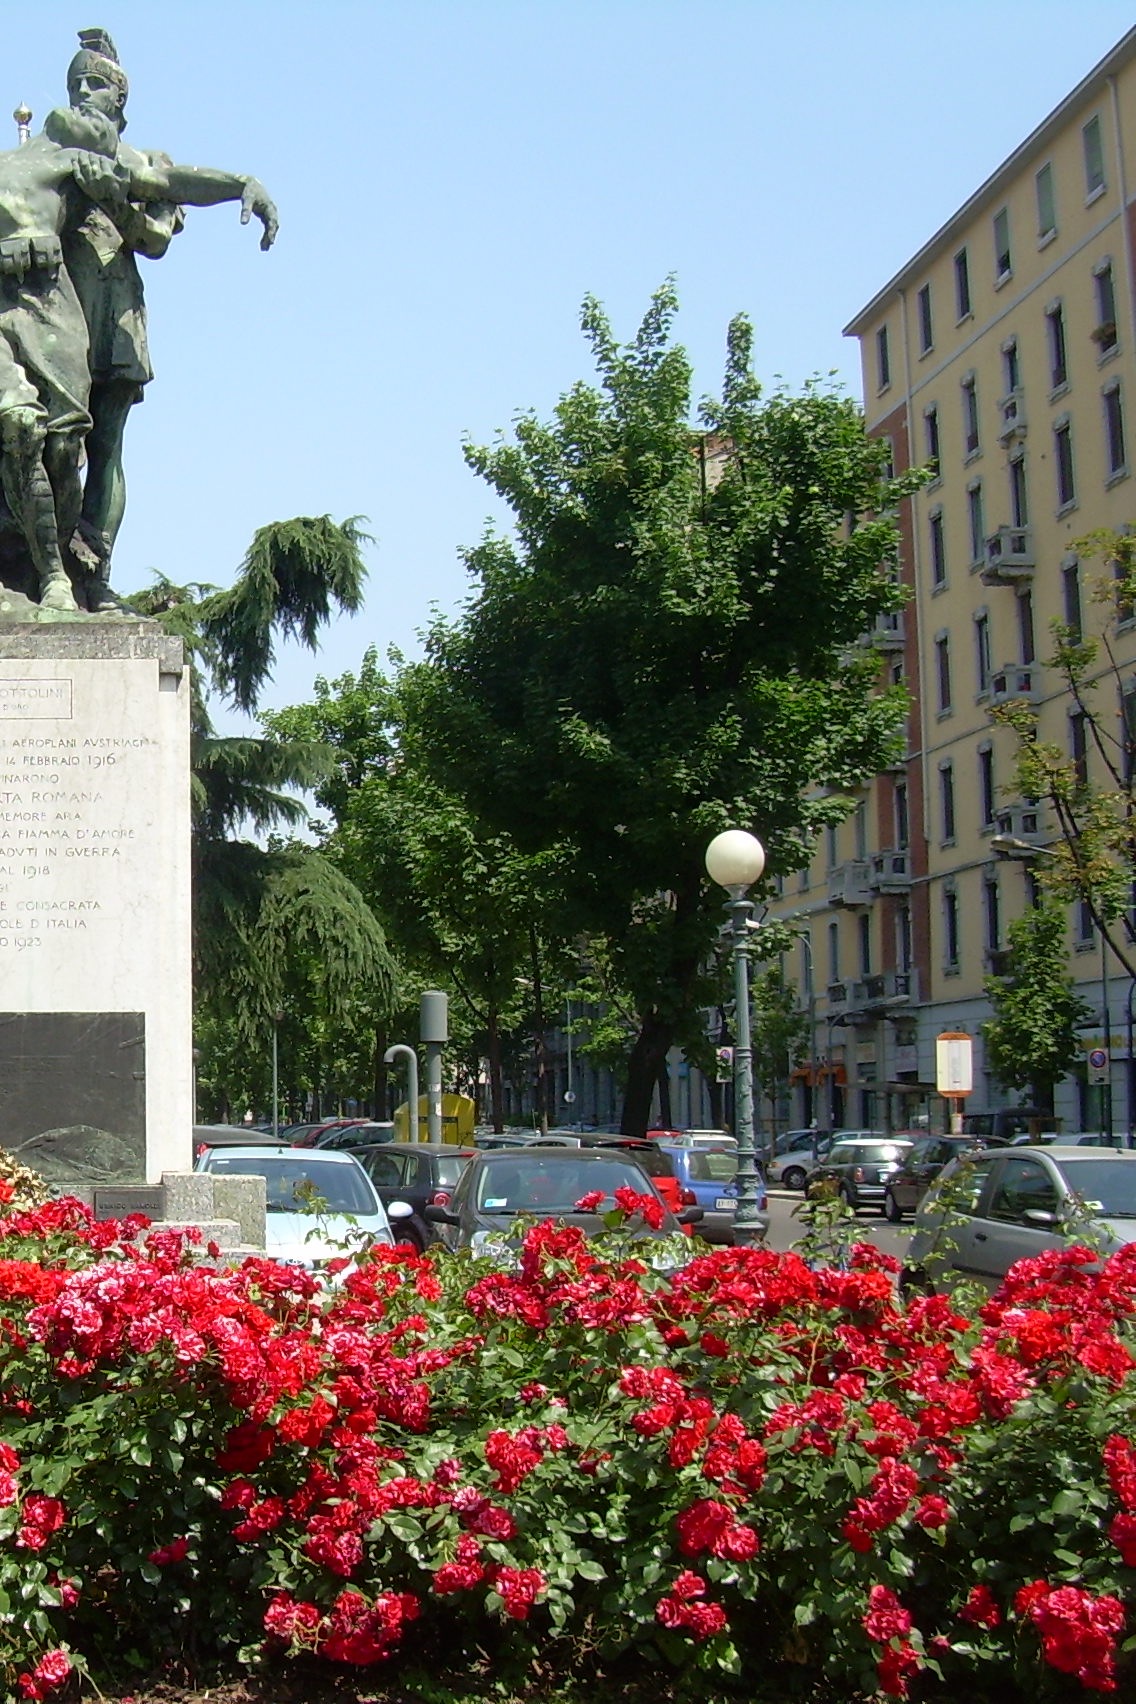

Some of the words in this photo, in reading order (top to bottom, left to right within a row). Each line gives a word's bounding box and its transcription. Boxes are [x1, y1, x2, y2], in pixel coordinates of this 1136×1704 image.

[12, 738, 77, 748] AEROPLANI
[22, 756, 81, 766] FEBBRAIO
[88, 753, 117, 769] 1916
[31, 791, 103, 803] ROMANA
[18, 829, 70, 839] FIAMMA
[45, 847, 57, 857] IN
[65, 847, 121, 857] GVERRA
[22, 865, 51, 879] 1918
[16, 900, 103, 911] CONSACRATA
[14, 937, 42, 950] 1923
